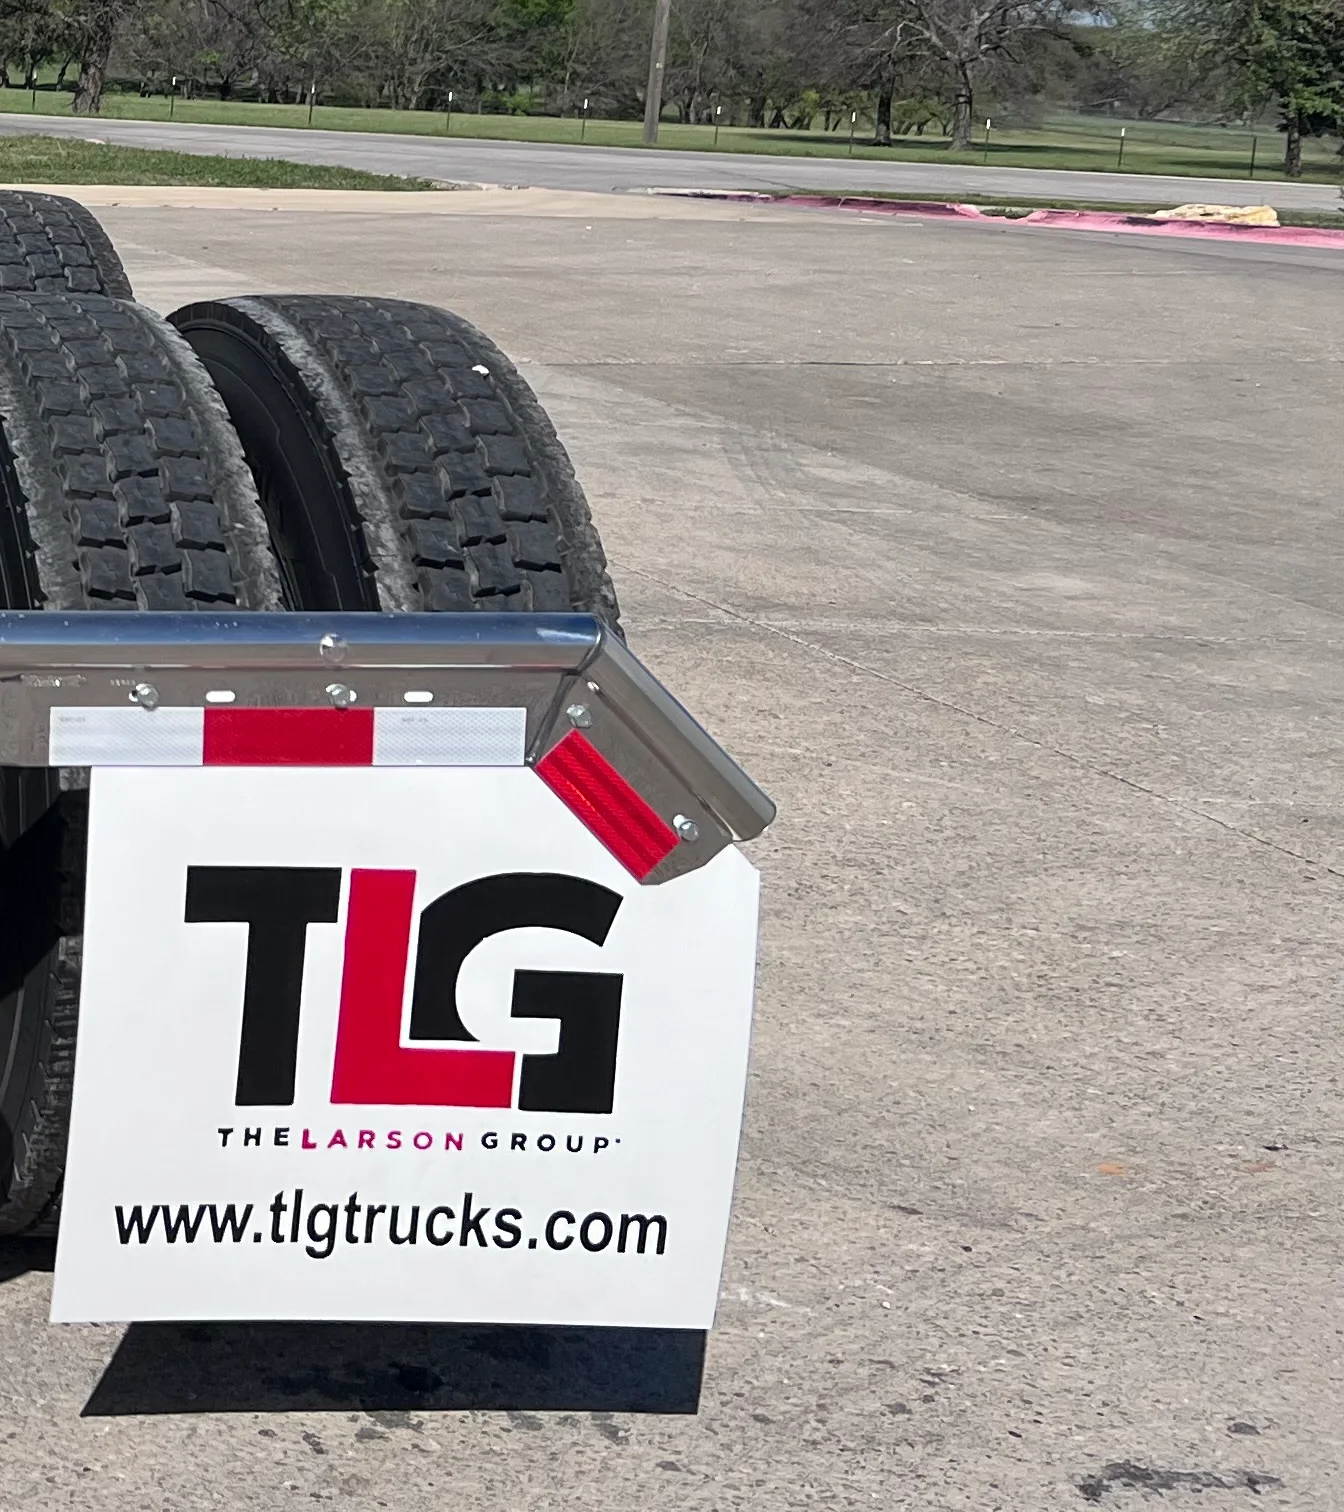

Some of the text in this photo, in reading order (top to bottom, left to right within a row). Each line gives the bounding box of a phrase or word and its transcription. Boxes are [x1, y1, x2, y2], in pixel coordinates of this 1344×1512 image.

[184, 864, 624, 1115] TLG
[481, 1131, 609, 1154] GROUP
[114, 1188, 668, 1259] www.tlgtrucks.com
